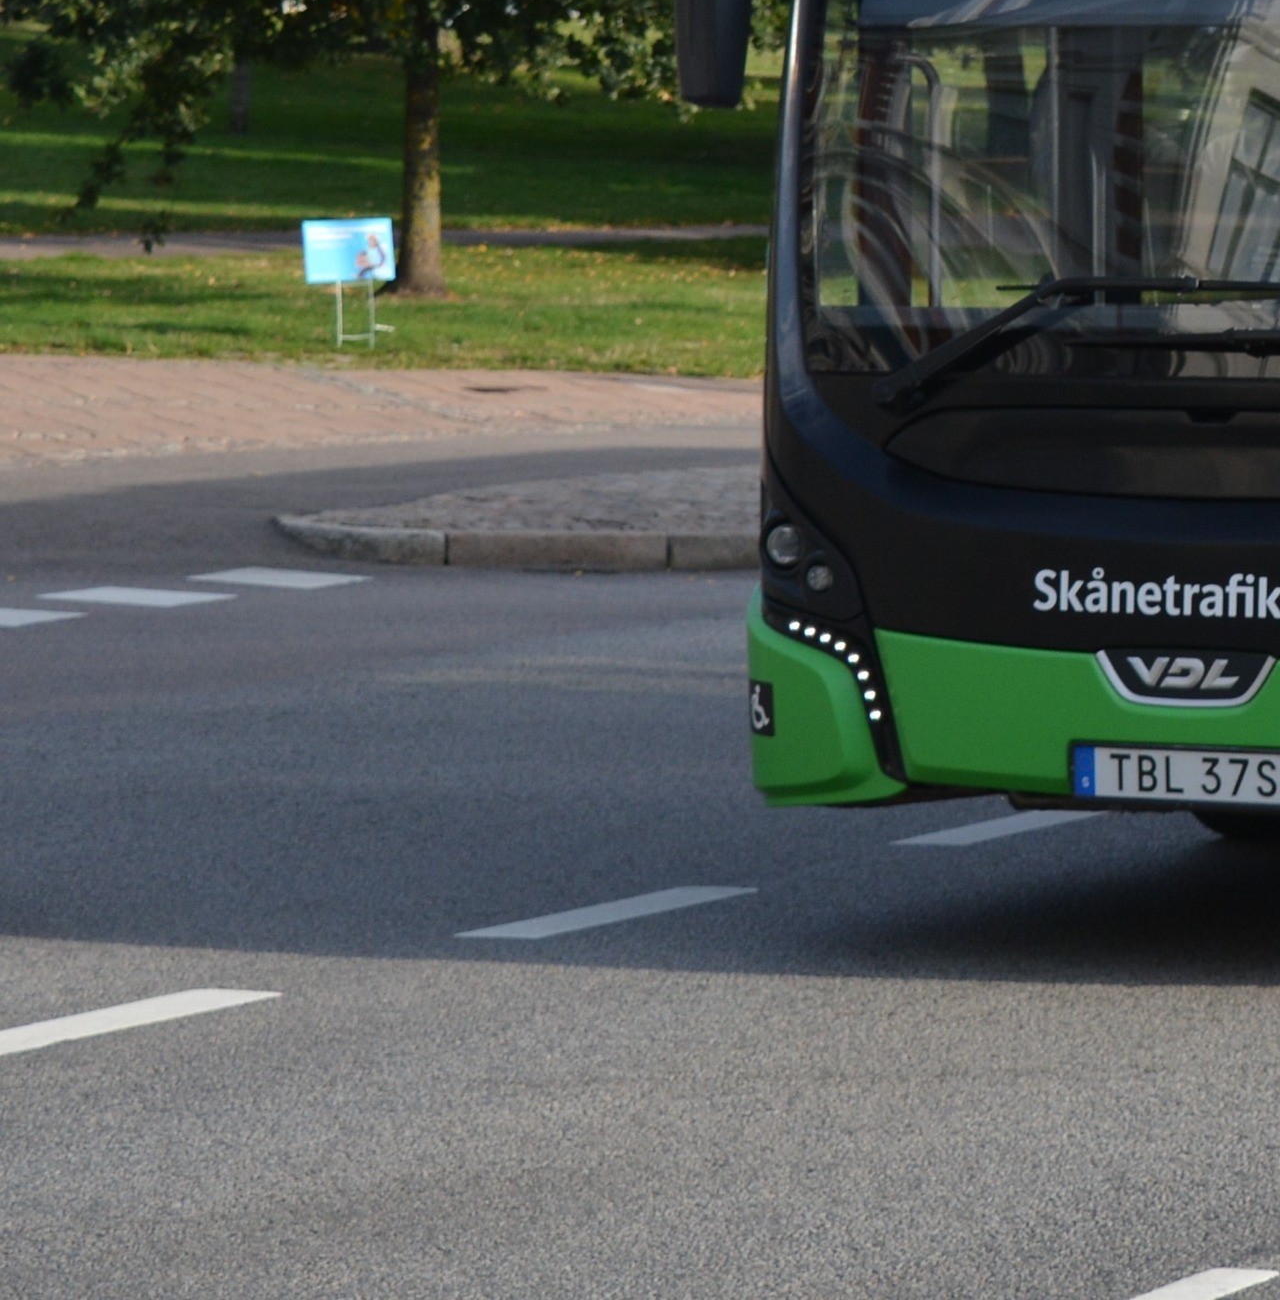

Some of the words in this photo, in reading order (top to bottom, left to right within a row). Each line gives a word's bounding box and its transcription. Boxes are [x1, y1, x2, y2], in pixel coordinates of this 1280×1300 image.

[1126, 655, 1240, 690] VDL
[1081, 776, 1091, 789] S
[1109, 753, 1185, 793] TBL
[1200, 757, 1278, 797] 37S
